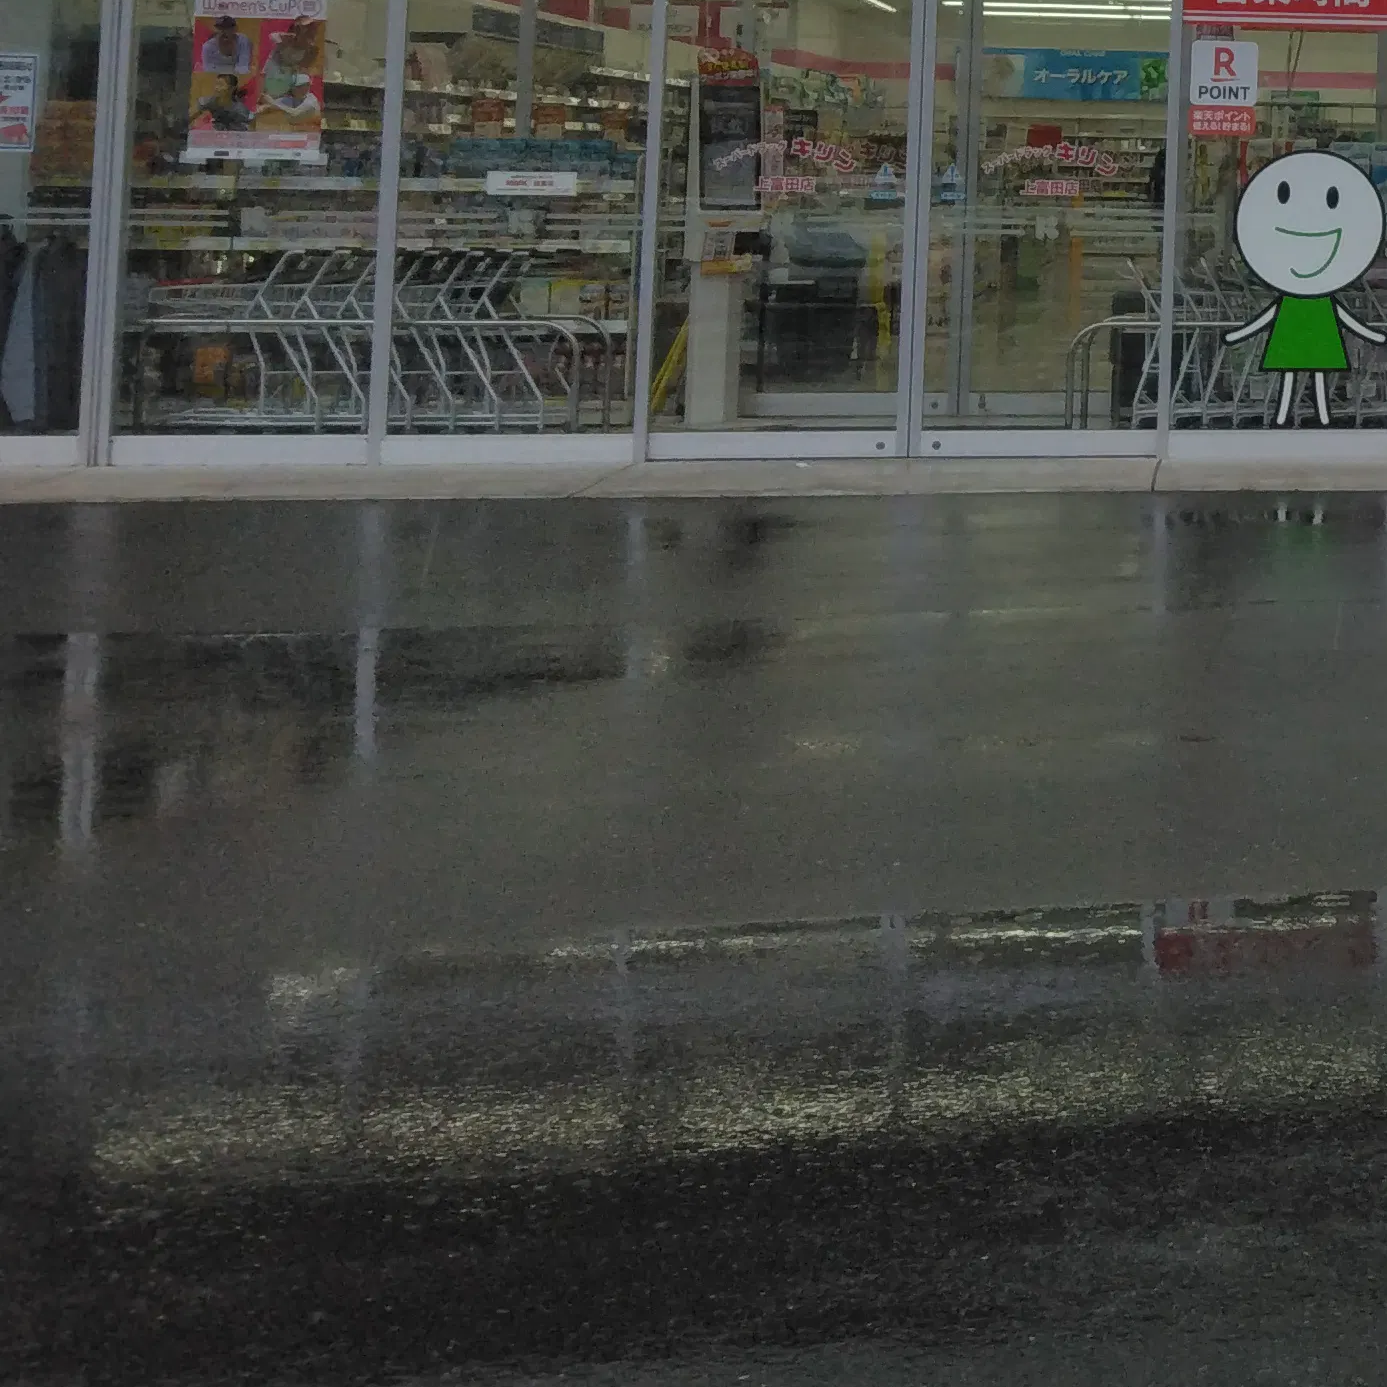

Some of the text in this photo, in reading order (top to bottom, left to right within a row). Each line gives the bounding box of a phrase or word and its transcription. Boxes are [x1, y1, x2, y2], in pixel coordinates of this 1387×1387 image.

[1210, 46, 1241, 83] R
[1033, 67, 1128, 86] オーラルケア
[1198, 85, 1251, 101] POINT
[790, 136, 857, 173] キリン
[1054, 141, 1119, 176] キリン
[754, 175, 816, 193] 上富田店
[1020, 178, 1080, 196] 上富田店
